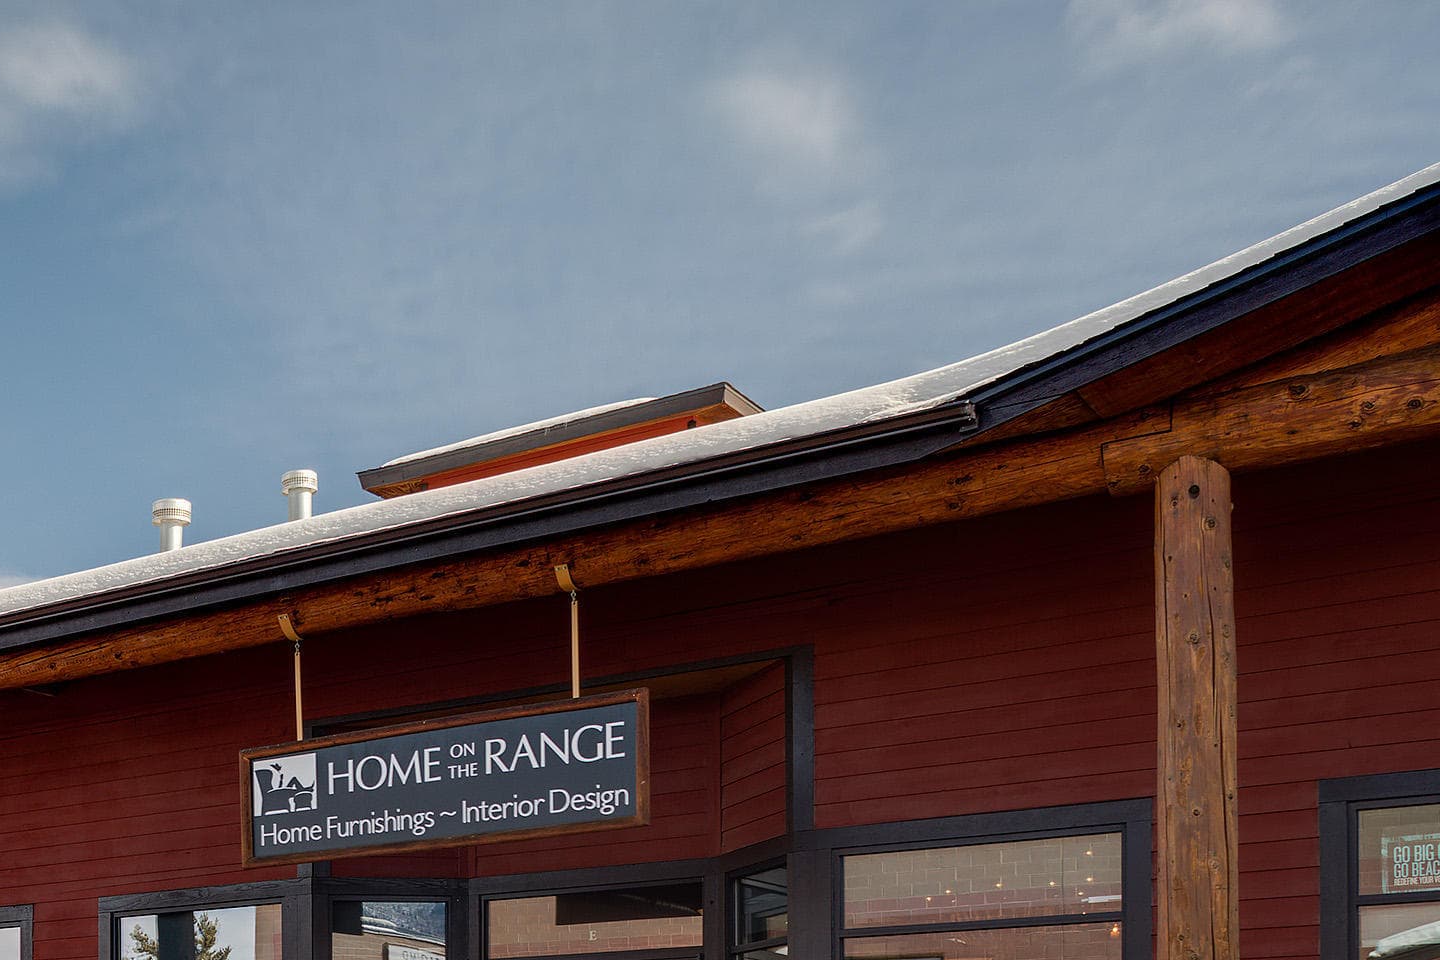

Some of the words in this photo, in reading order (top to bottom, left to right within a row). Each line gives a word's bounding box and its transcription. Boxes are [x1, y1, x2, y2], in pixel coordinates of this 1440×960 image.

[449, 742, 475, 759] ON
[485, 721, 626, 775] RANGE
[327, 747, 442, 795] HOME
[447, 762, 479, 779] THE
[260, 823, 323, 847] Home
[326, 808, 435, 836] Furnishings
[461, 794, 546, 824] Interior
[548, 784, 630, 815] Design
[1393, 845, 1410, 864] GO
[1414, 843, 1434, 862] BIG
[1393, 862, 1409, 879] GO
